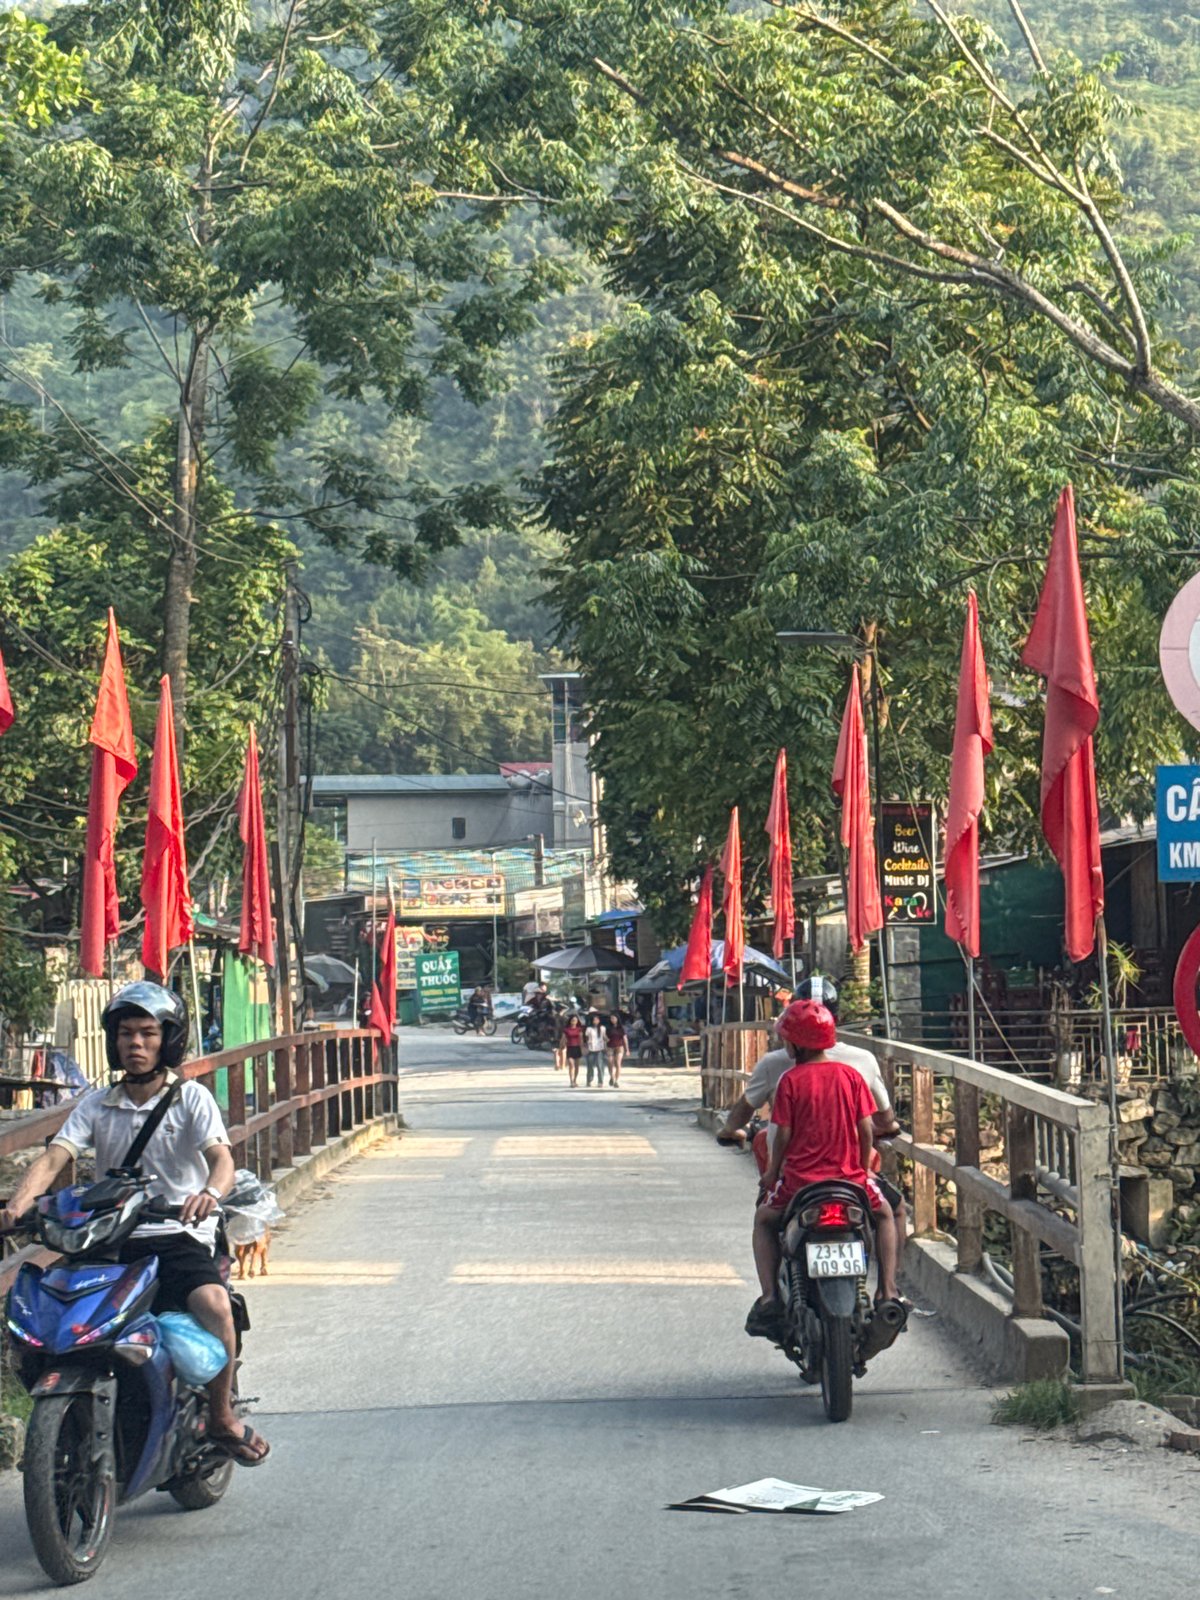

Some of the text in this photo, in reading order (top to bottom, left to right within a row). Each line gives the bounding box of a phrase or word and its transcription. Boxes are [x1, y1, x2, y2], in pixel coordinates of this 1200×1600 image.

[894, 823, 917, 837] Beer
[893, 841, 920, 854] Wine
[884, 858, 929, 872] Cocktails
[884, 875, 930, 888] Music DJ
[420, 970, 458, 987] THUỐC
[815, 1244, 854, 1260] 23-K1
[813, 1260, 862, 1276] 109.96
